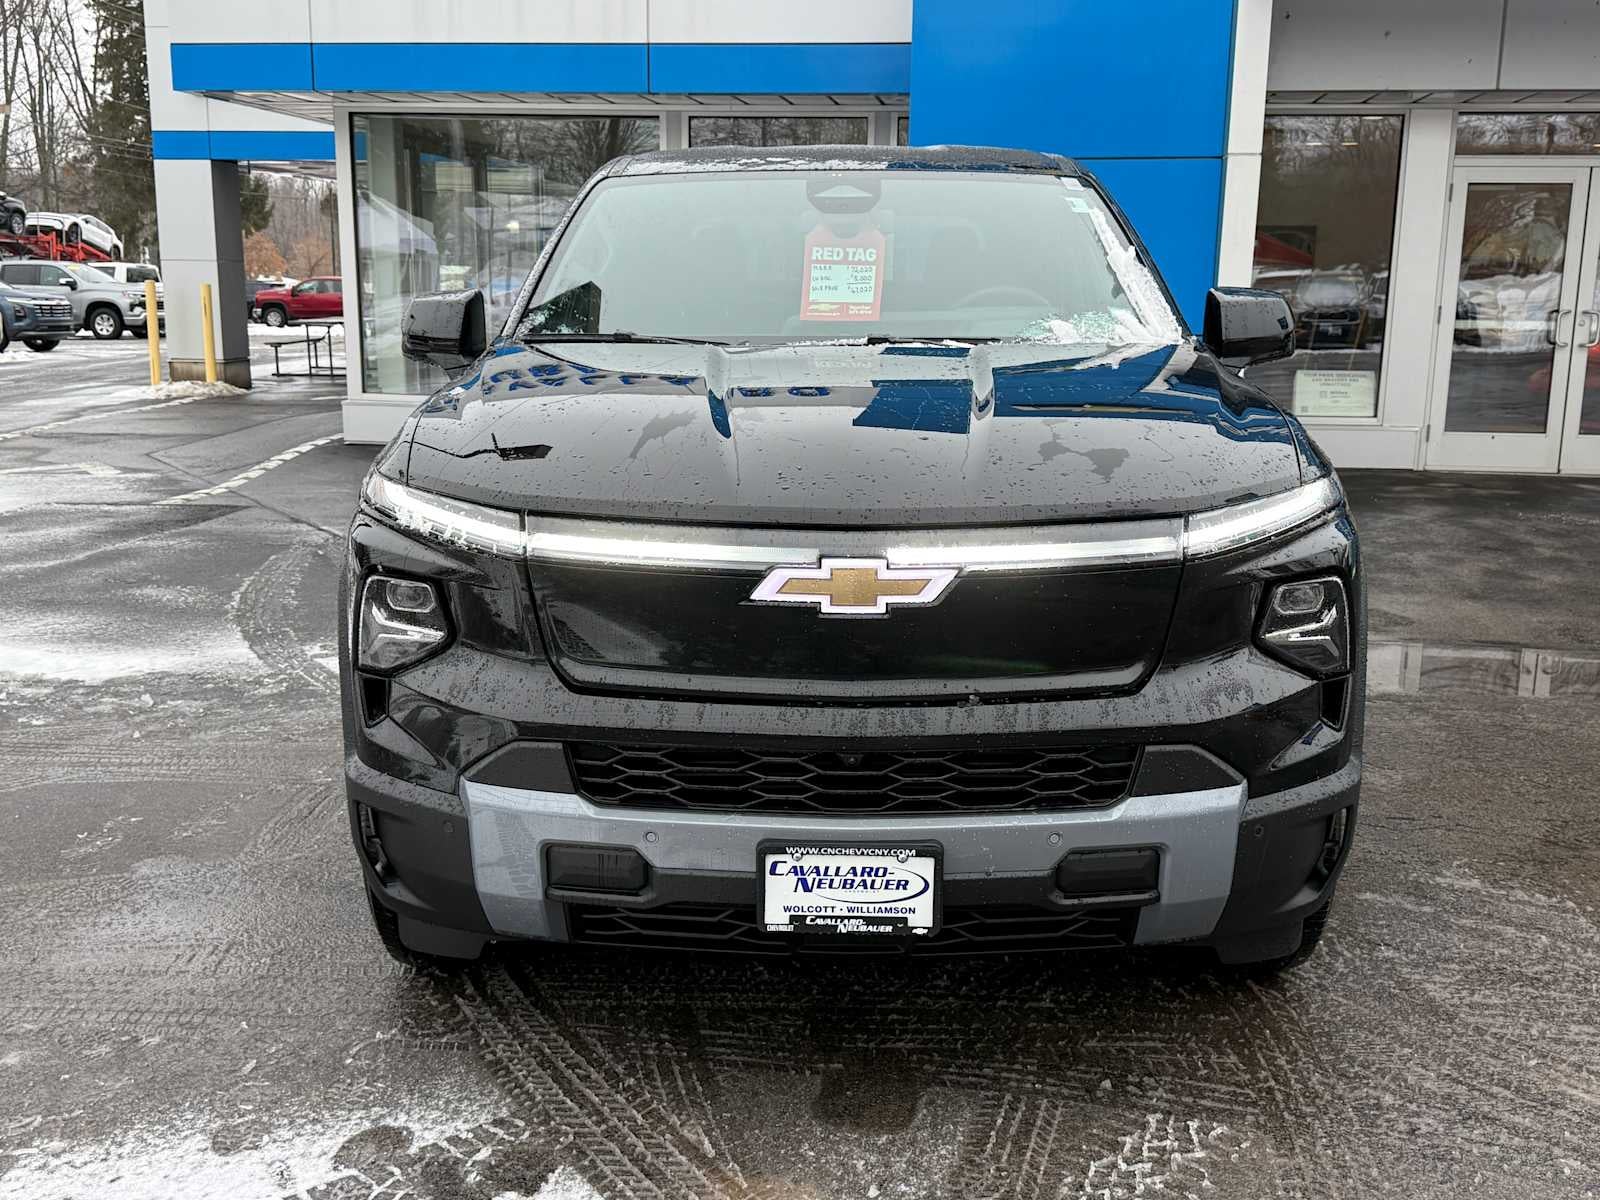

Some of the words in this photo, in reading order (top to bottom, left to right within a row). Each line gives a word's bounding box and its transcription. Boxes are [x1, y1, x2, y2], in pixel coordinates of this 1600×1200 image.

[811, 247, 844, 260] RED
[846, 247, 877, 261] TAG
[785, 846, 916, 857] WWW.CNCHEVYCNY.COM
[769, 860, 895, 878] CAVALLARO-
[793, 877, 910, 893] NEUBAUER
[783, 905, 837, 913] WOLCOTT
[847, 905, 916, 915] WILLIAMSON
[837, 923, 893, 933] NEUBAUER
